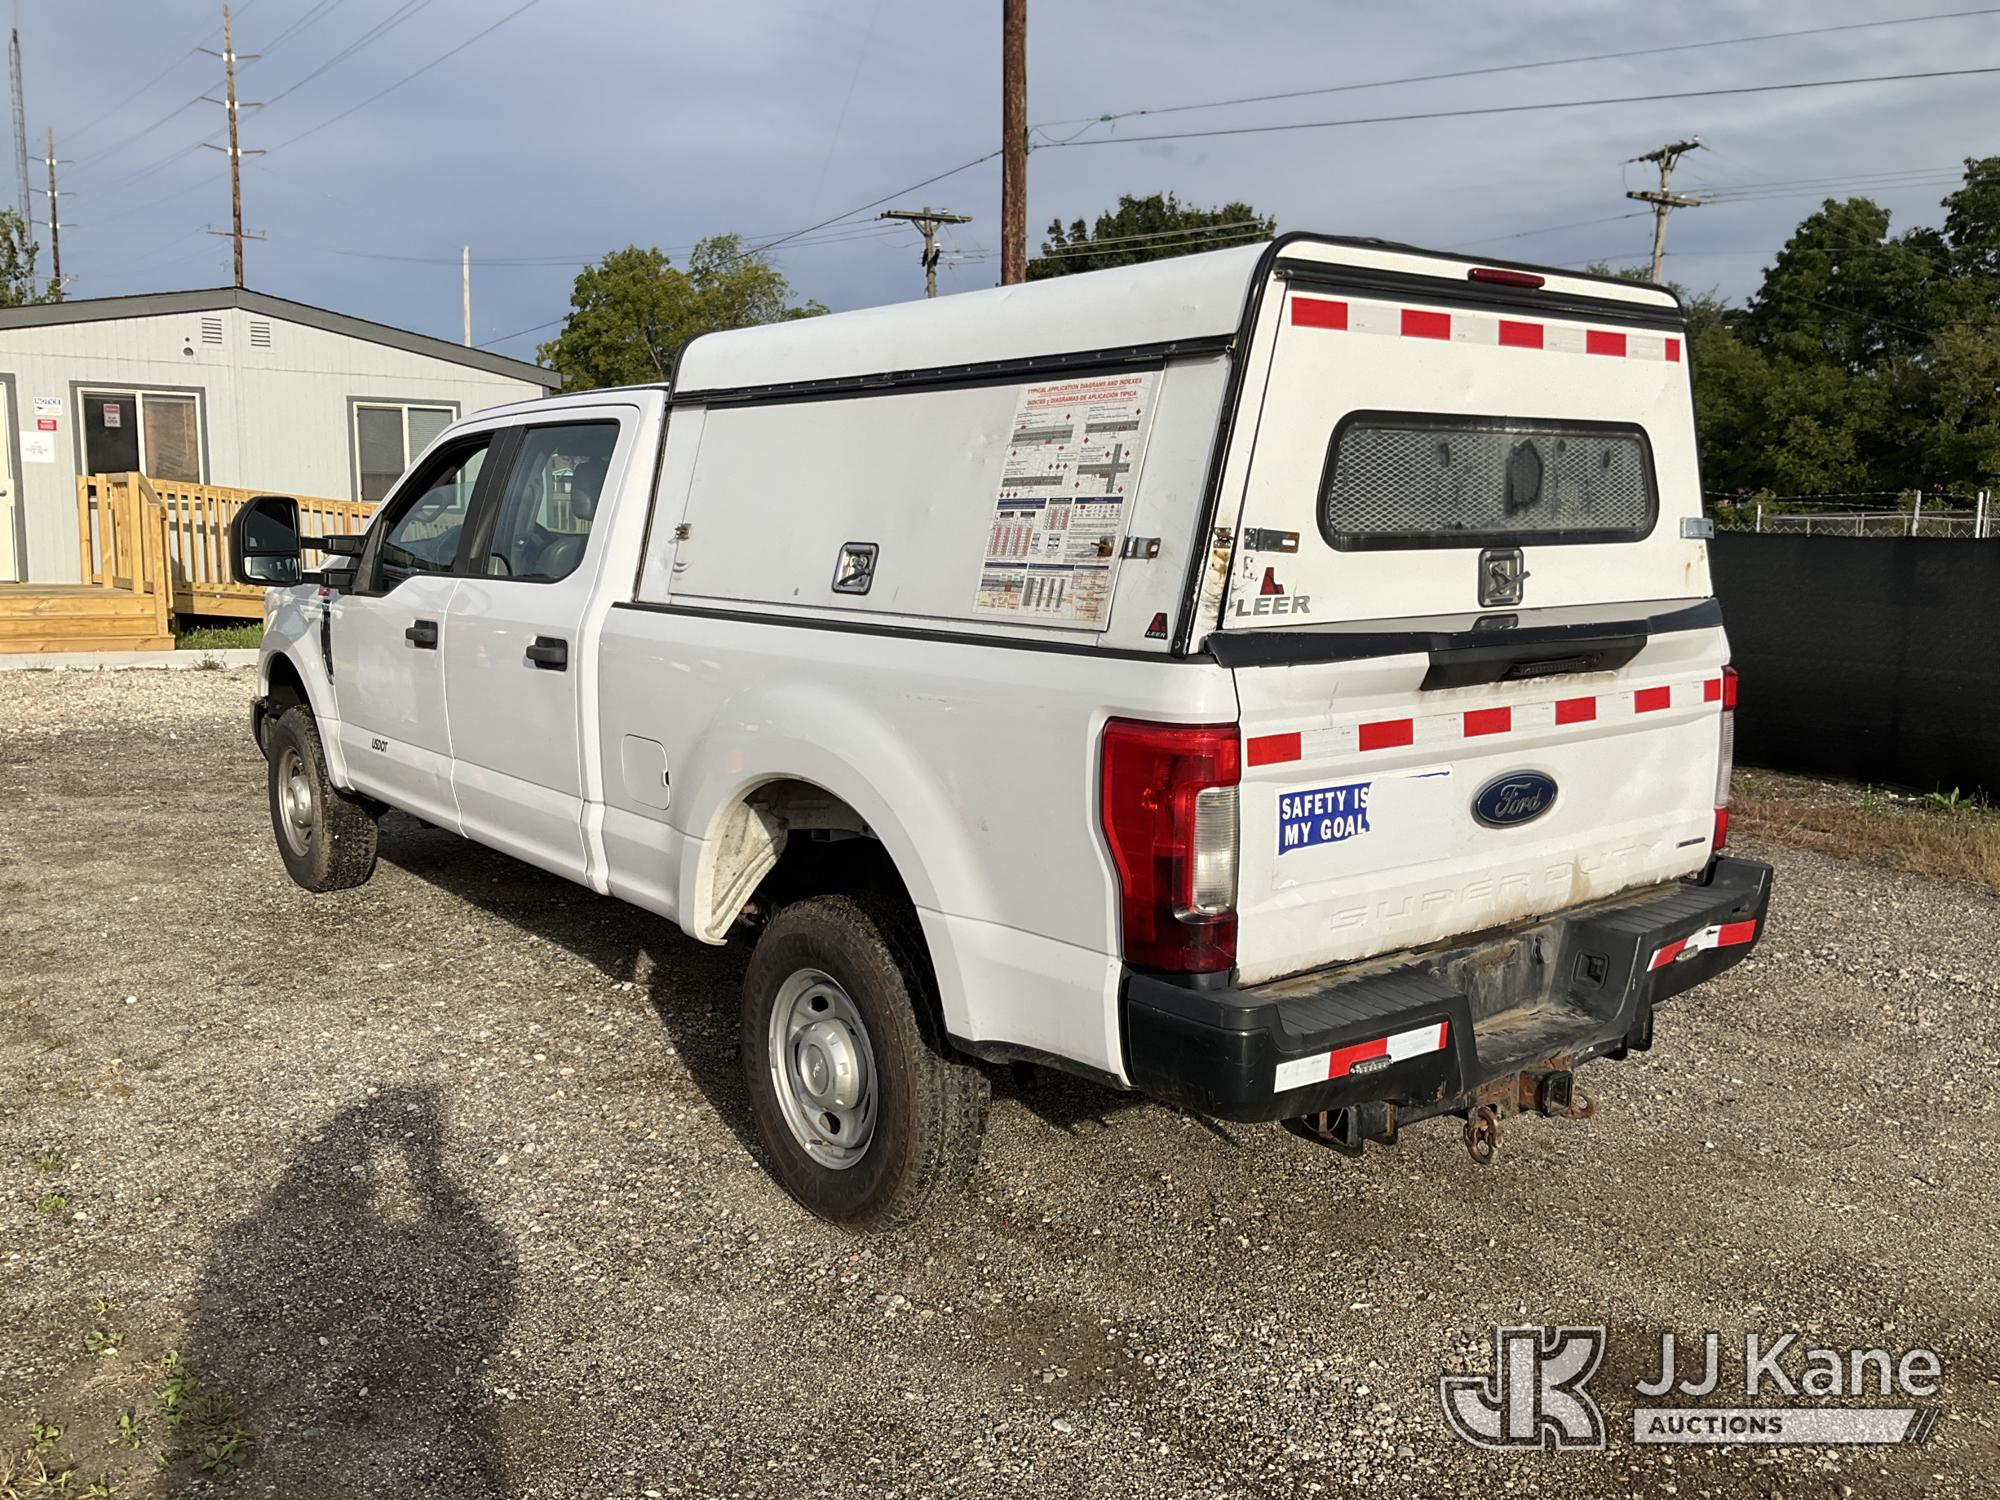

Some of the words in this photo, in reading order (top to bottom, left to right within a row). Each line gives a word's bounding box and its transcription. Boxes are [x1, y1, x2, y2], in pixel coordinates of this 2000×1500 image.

[1235, 595, 1311, 617] LEER
[1281, 789, 1349, 820] SAFETY
[1352, 786, 1369, 811] IS
[1494, 782, 1541, 818] Ford
[1284, 822, 1311, 847] MY
[1320, 813, 1369, 842] GOAL
[1329, 871, 1530, 931] SUPER
[1545, 840, 1663, 884] DUTY
